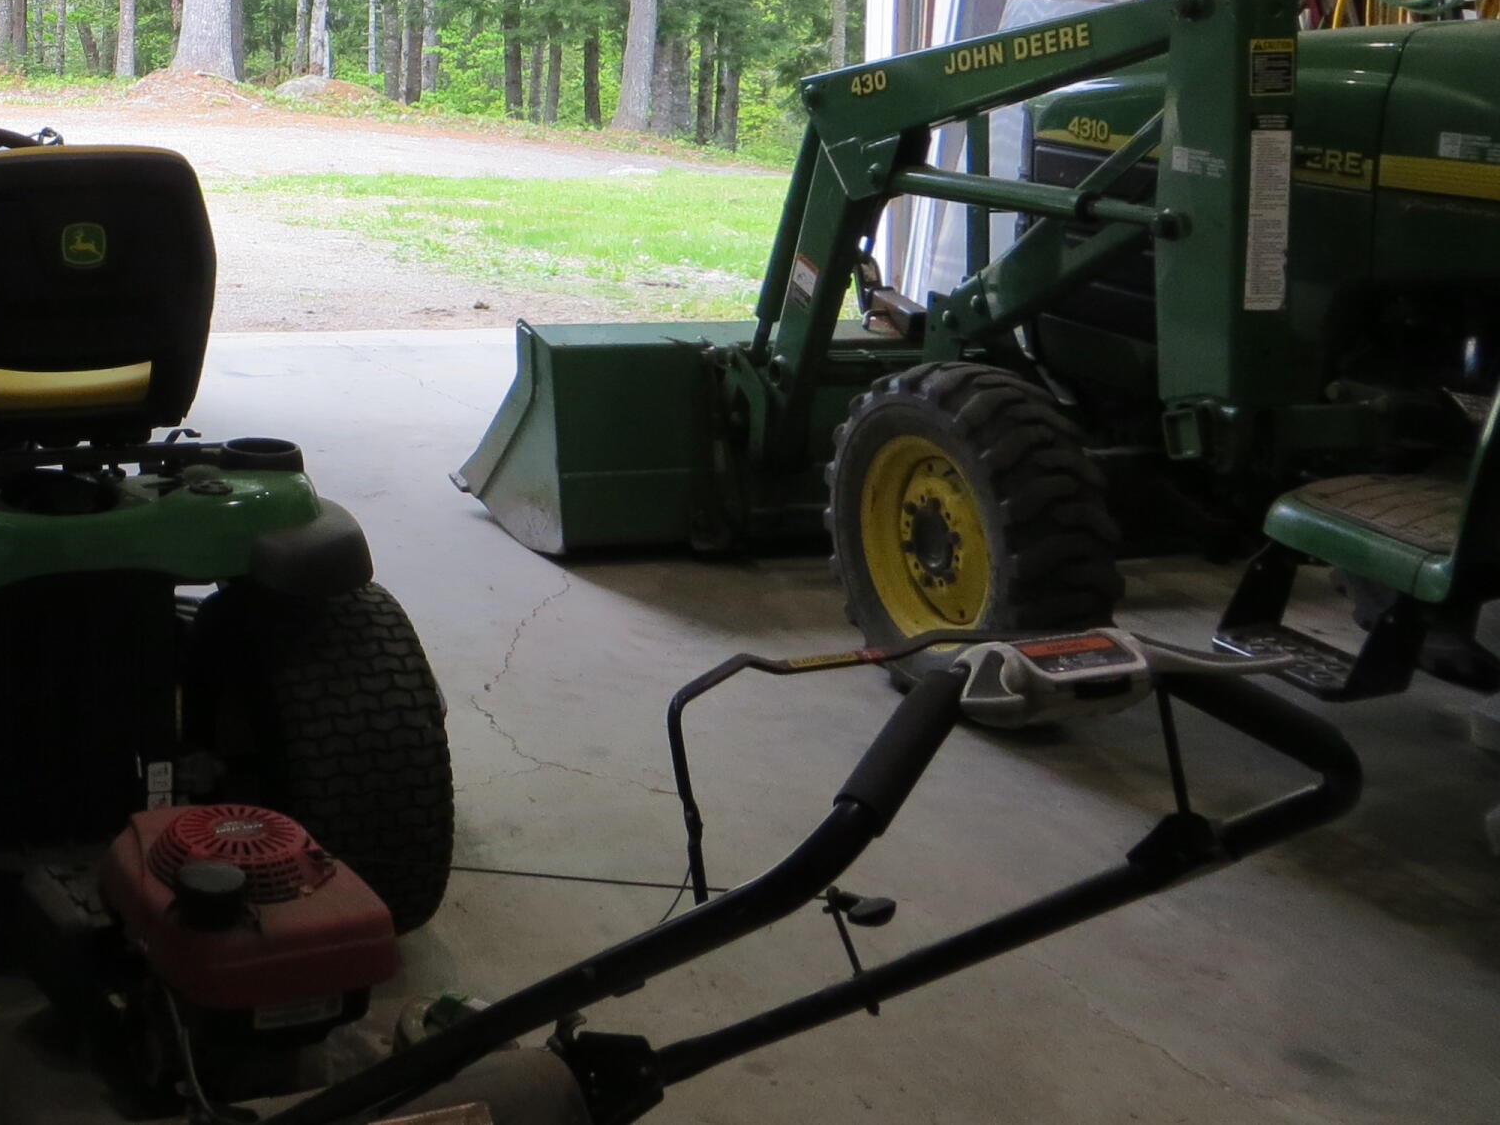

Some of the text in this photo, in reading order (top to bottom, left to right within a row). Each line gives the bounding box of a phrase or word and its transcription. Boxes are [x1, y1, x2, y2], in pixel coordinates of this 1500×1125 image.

[943, 22, 1091, 75] JOHN DEERE
[850, 70, 888, 96] 430
[1067, 116, 1110, 142] 4310
